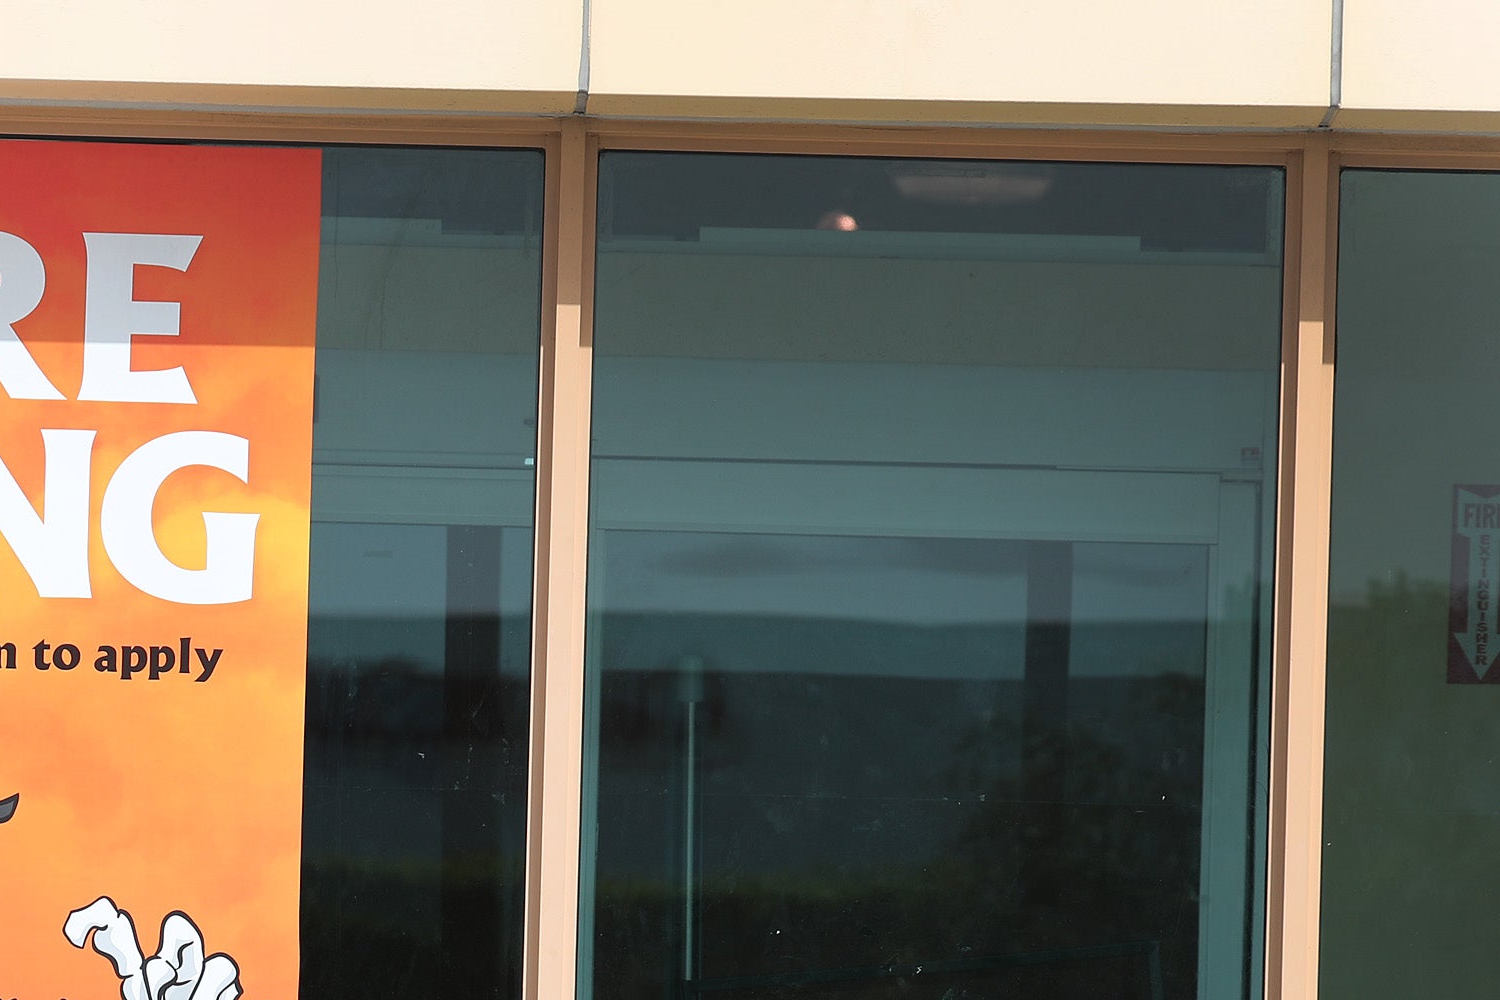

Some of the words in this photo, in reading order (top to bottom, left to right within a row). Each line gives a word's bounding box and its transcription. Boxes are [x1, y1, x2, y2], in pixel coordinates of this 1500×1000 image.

[1463, 503, 1500, 528] FIR
[1475, 534, 1491, 665] EXTINGUISHER
[32, 638, 82, 671] to
[93, 637, 224, 682] apply
